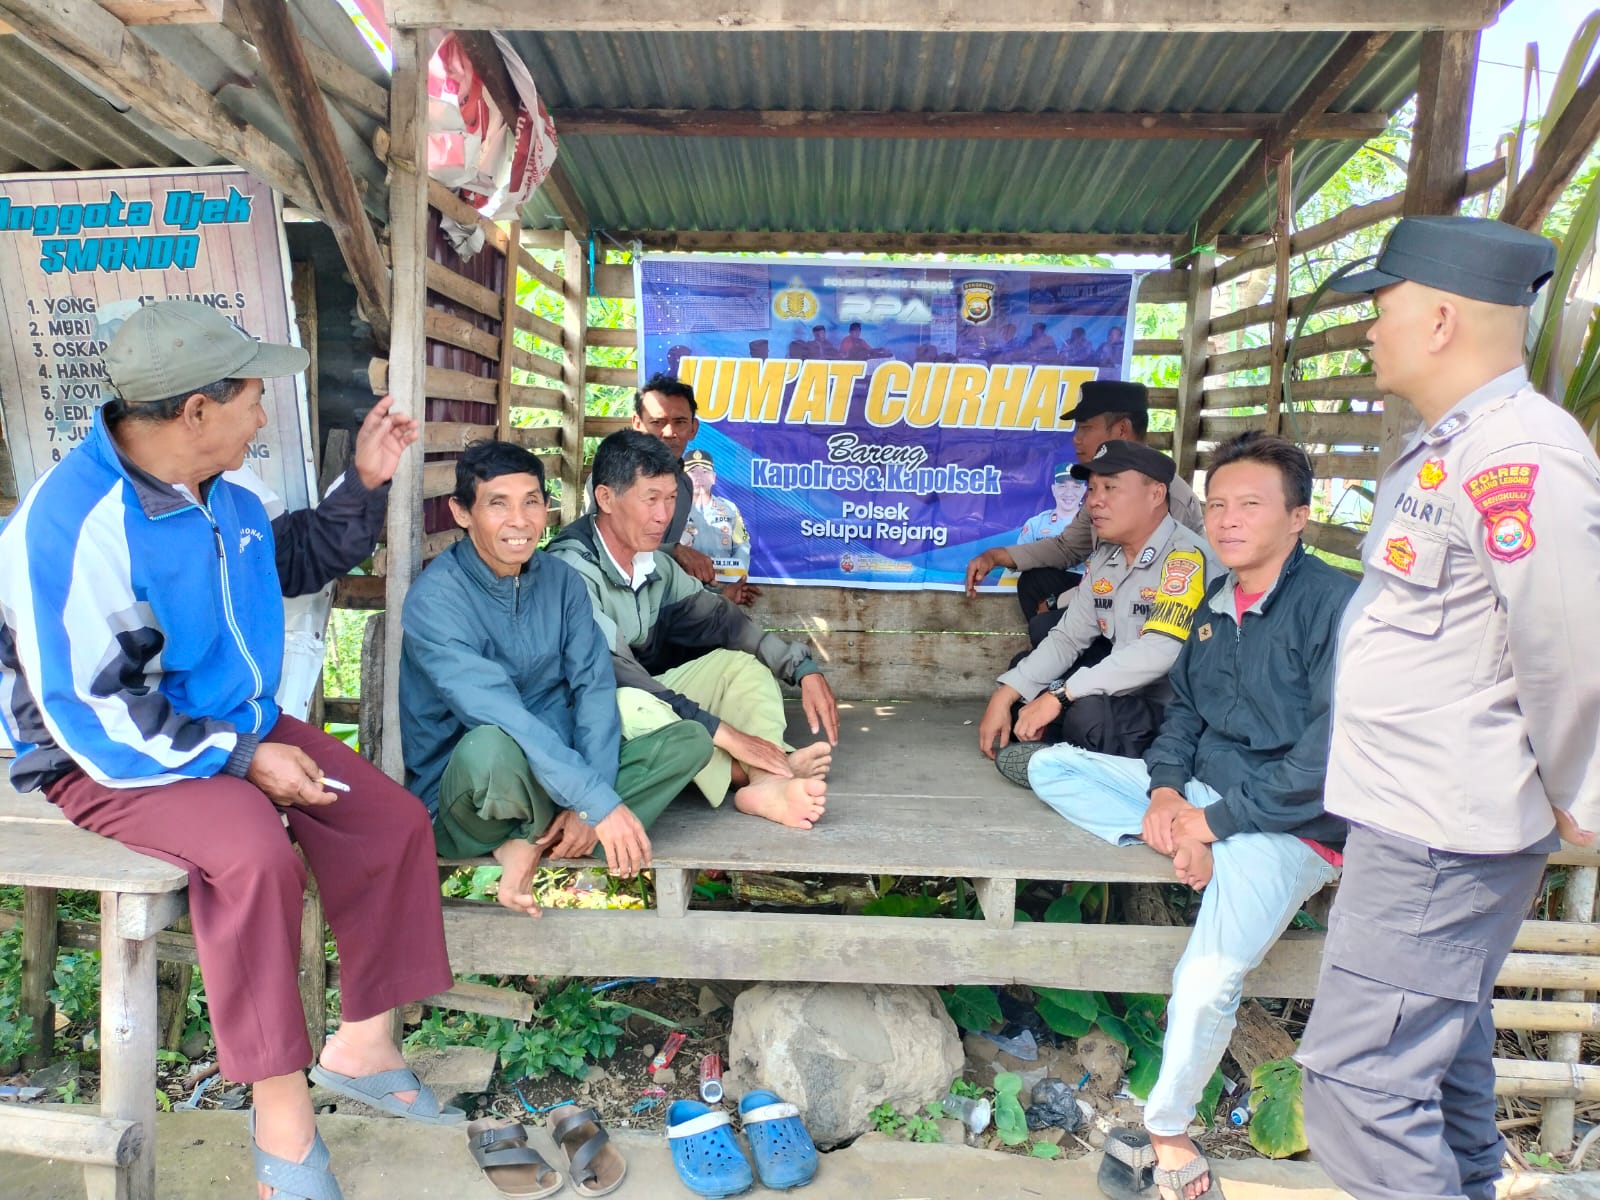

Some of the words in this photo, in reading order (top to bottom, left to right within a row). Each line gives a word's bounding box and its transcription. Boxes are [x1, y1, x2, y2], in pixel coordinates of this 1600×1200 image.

[163, 187, 253, 231] Ojek
[40, 234, 200, 274] SMANDA
[27, 299, 40, 314] 1.
[44, 298, 96, 314] YONG
[28, 321, 44, 337] 2.
[48, 319, 91, 336] MURI
[32, 342, 48, 358] 3.
[38, 363, 53, 379] 4.
[40, 385, 56, 400] 5.
[60, 383, 102, 400] YOVI
[865, 361, 1100, 430] CURHAT
[44, 406, 59, 421] 6.
[46, 426, 62, 442] 7.
[828, 434, 927, 471] Bareng
[752, 459, 863, 491] Kapolres
[864, 468, 885, 491] &
[885, 464, 1002, 496] Kapolsek
[1469, 466, 1531, 491] POLRES
[842, 501, 910, 521] Polsek
[801, 519, 873, 544] Selupu
[876, 521, 949, 546] Rejang
